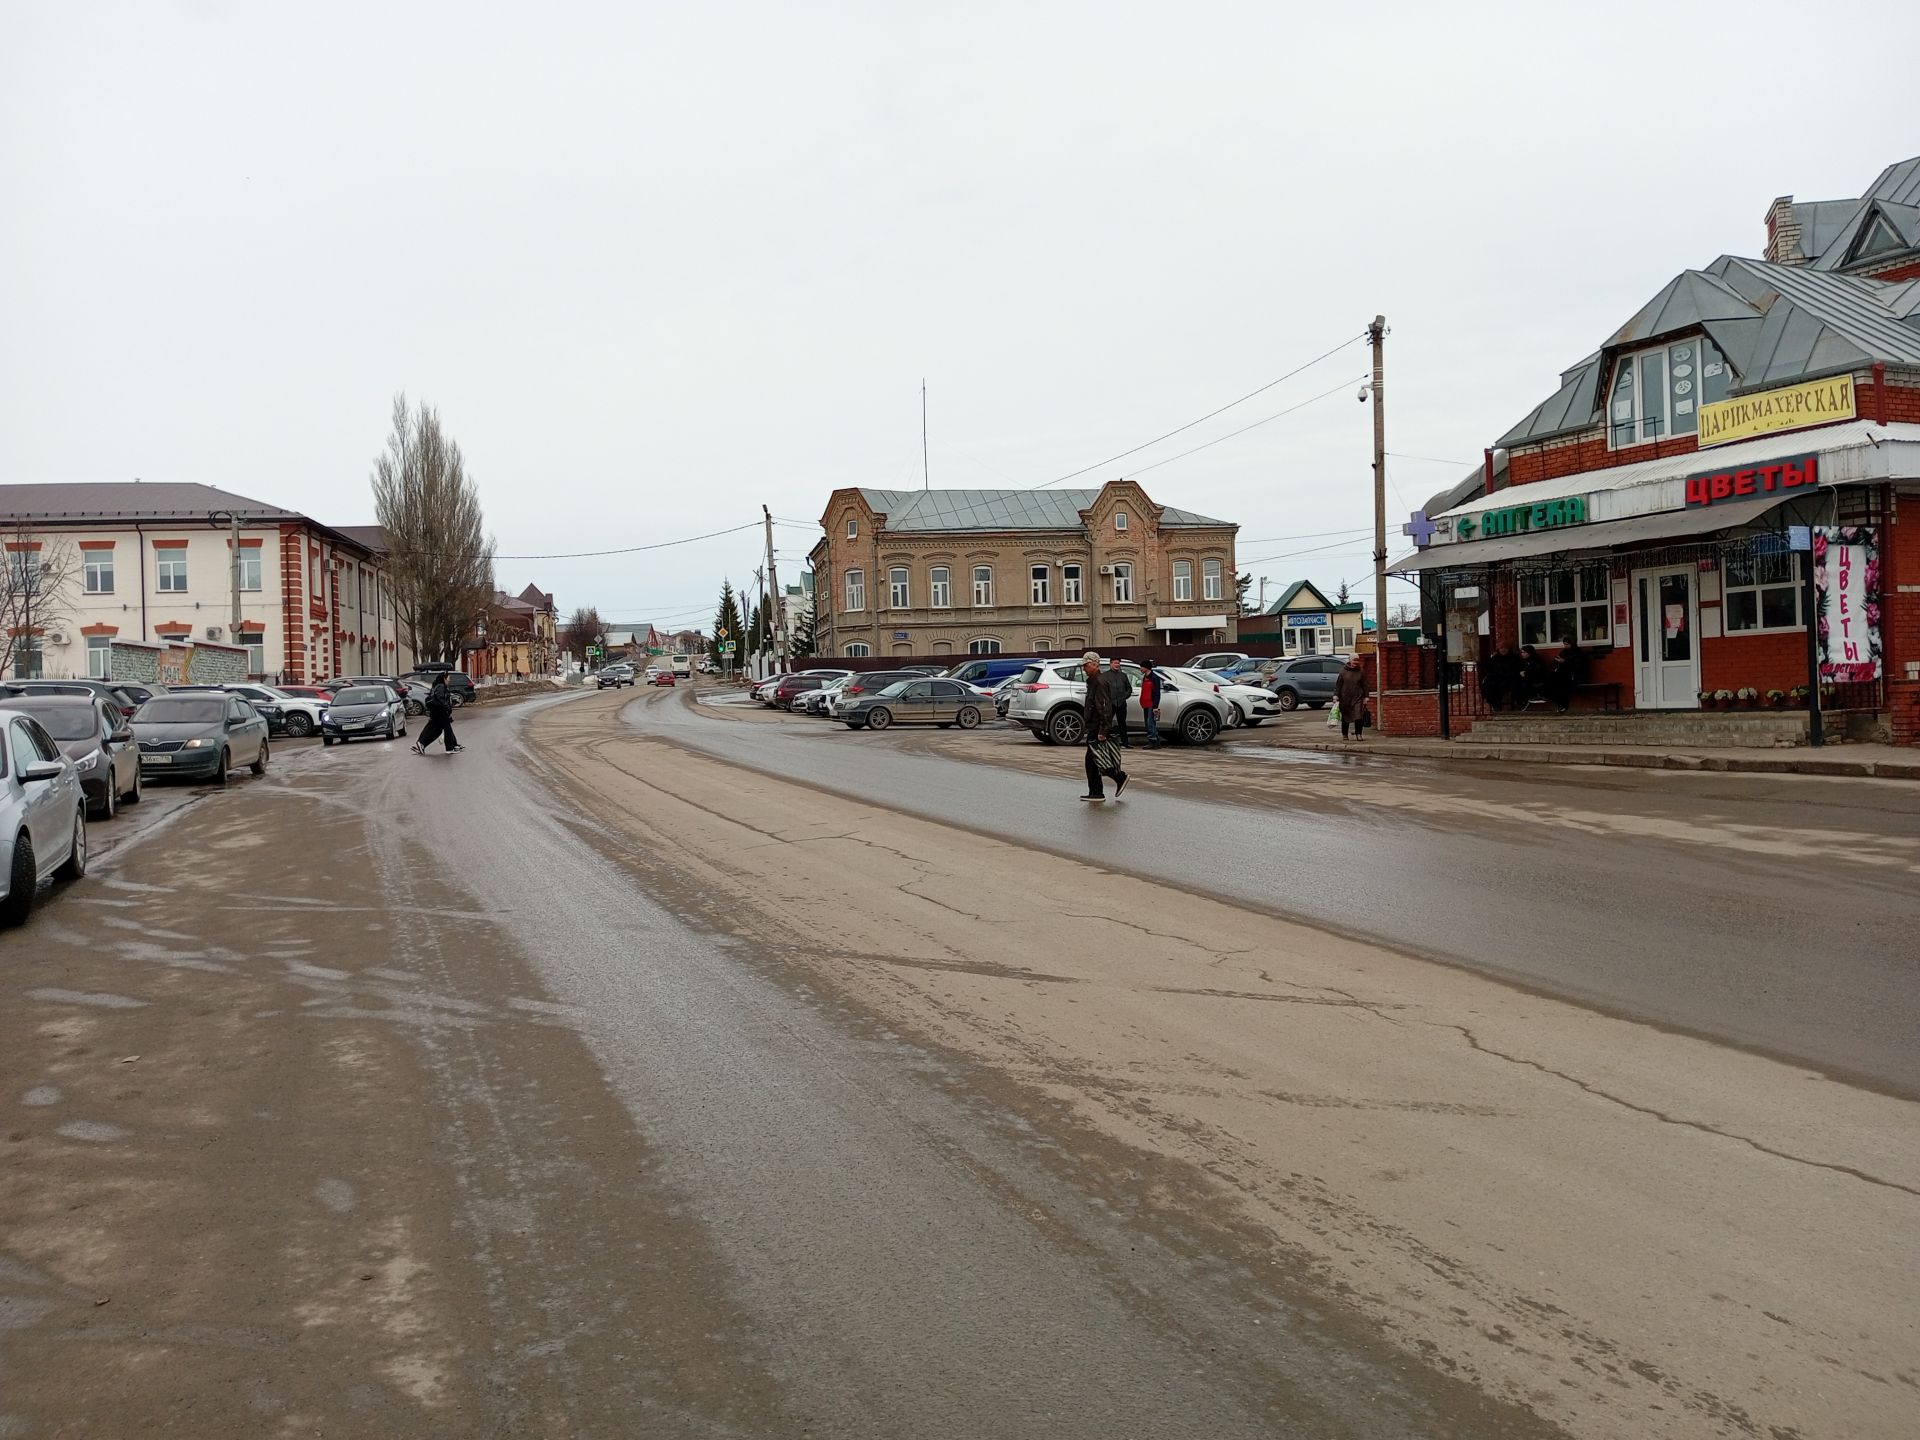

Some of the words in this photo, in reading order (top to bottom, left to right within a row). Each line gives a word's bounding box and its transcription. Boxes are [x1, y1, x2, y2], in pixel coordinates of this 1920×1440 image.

[1701, 382, 1851, 438] ПАРИКМАХЕРСКАЯ
[1687, 458, 1818, 506] ЦВЕТЫ
[1481, 496, 1585, 536] АПТЕКА
[1839, 546, 1859, 661] ЦВЕТЫ
